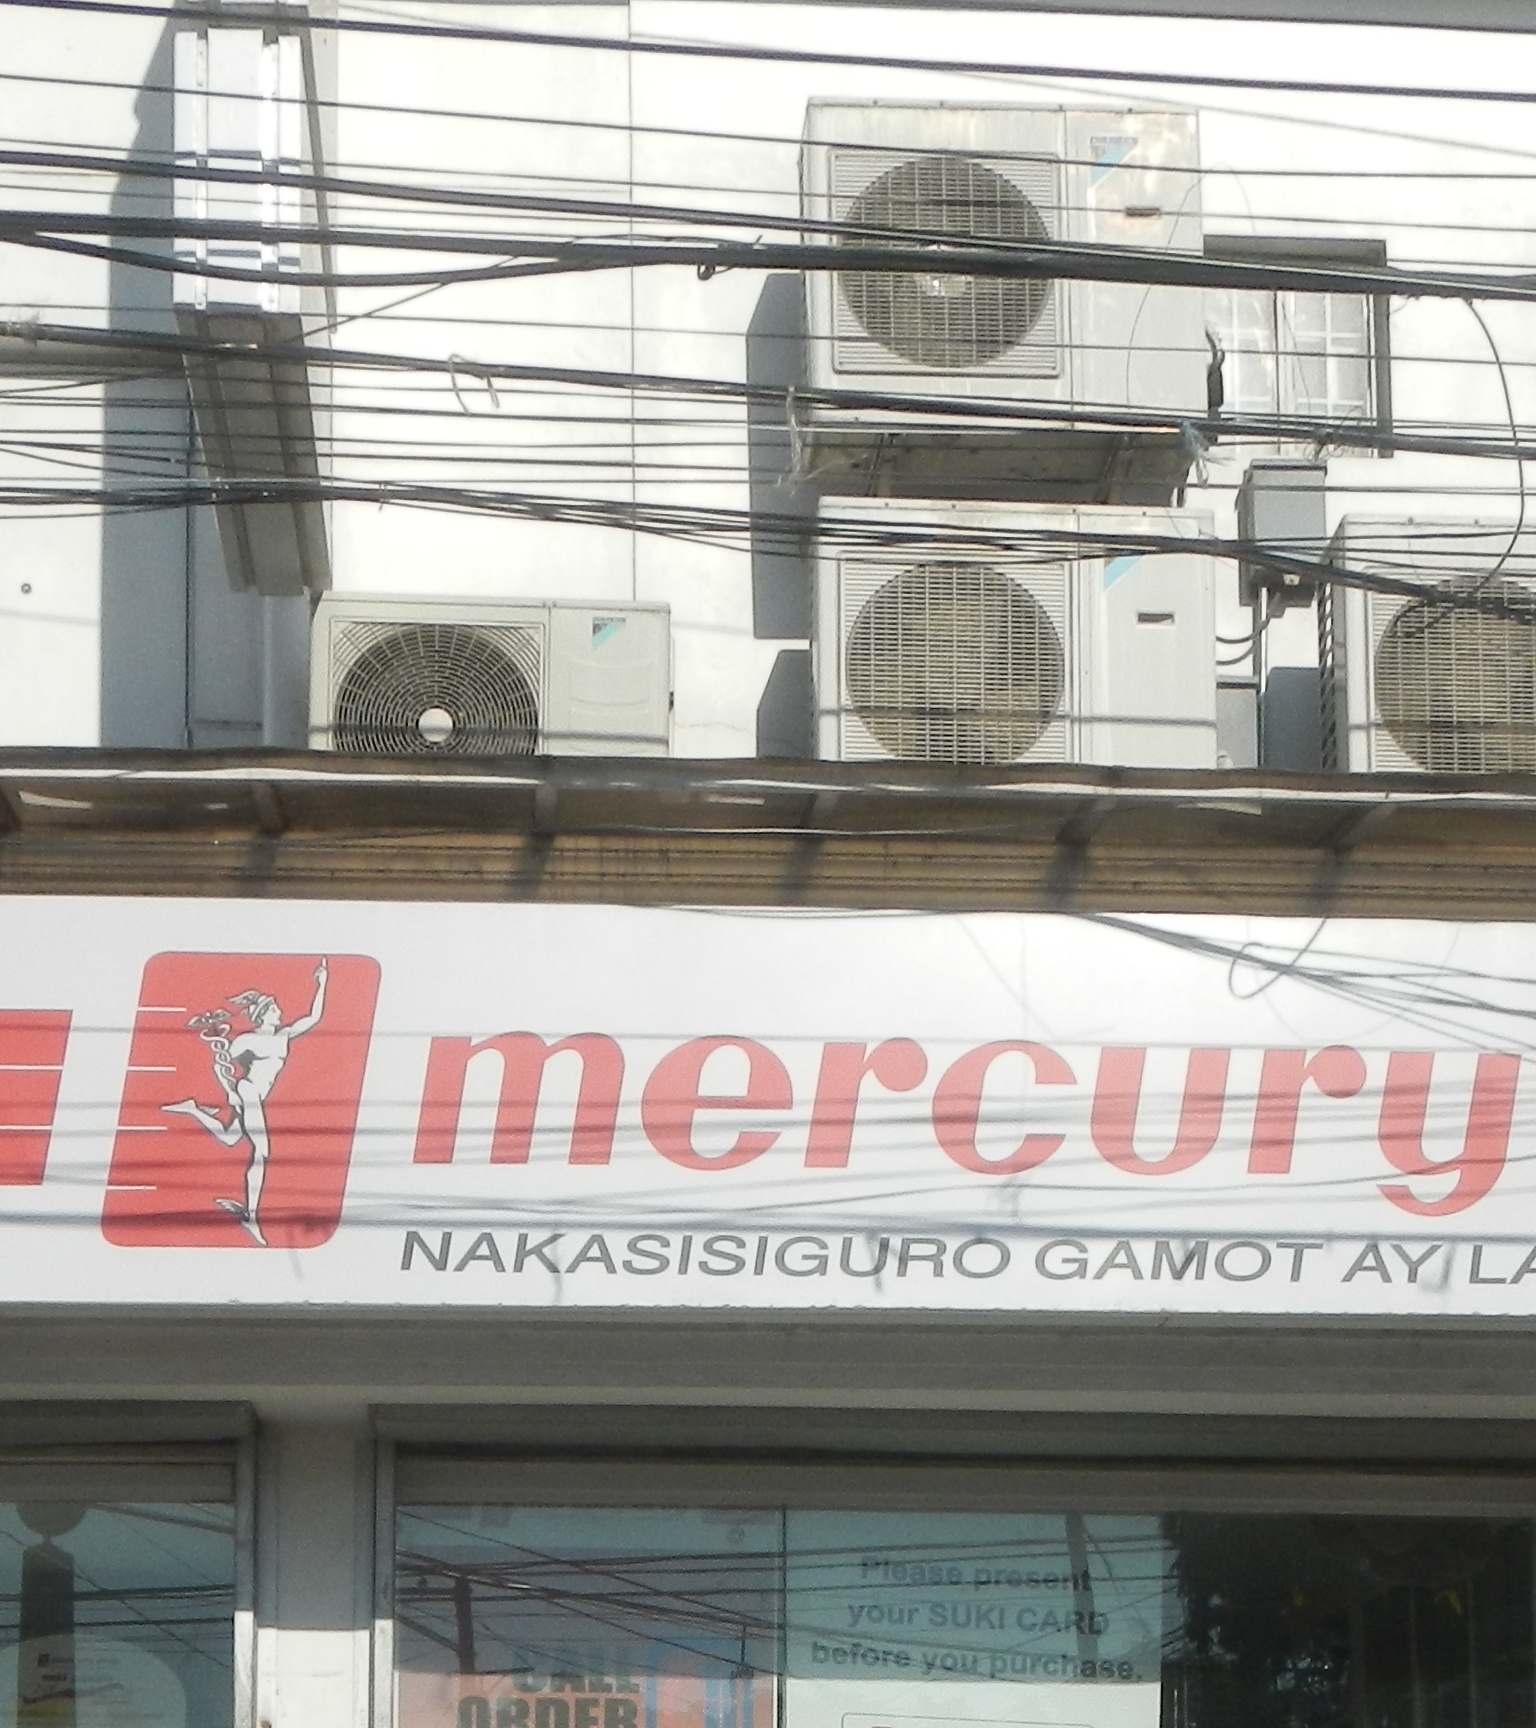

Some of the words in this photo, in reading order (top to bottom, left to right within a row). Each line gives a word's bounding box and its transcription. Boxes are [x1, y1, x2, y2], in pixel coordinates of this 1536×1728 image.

[413, 1031, 1522, 1217] mercury
[401, 1231, 1011, 1280] NAKASISIGURO
[1034, 1239, 1323, 1282] GAMOT
[1341, 1242, 1442, 1285] AY
[861, 1556, 961, 1584] Please
[974, 1562, 1091, 1594] present
[846, 1603, 920, 1628] your
[929, 1604, 1006, 1630] SUKI
[1016, 1608, 1109, 1635] CARD
[811, 1641, 911, 1668] before
[921, 1650, 979, 1676] you
